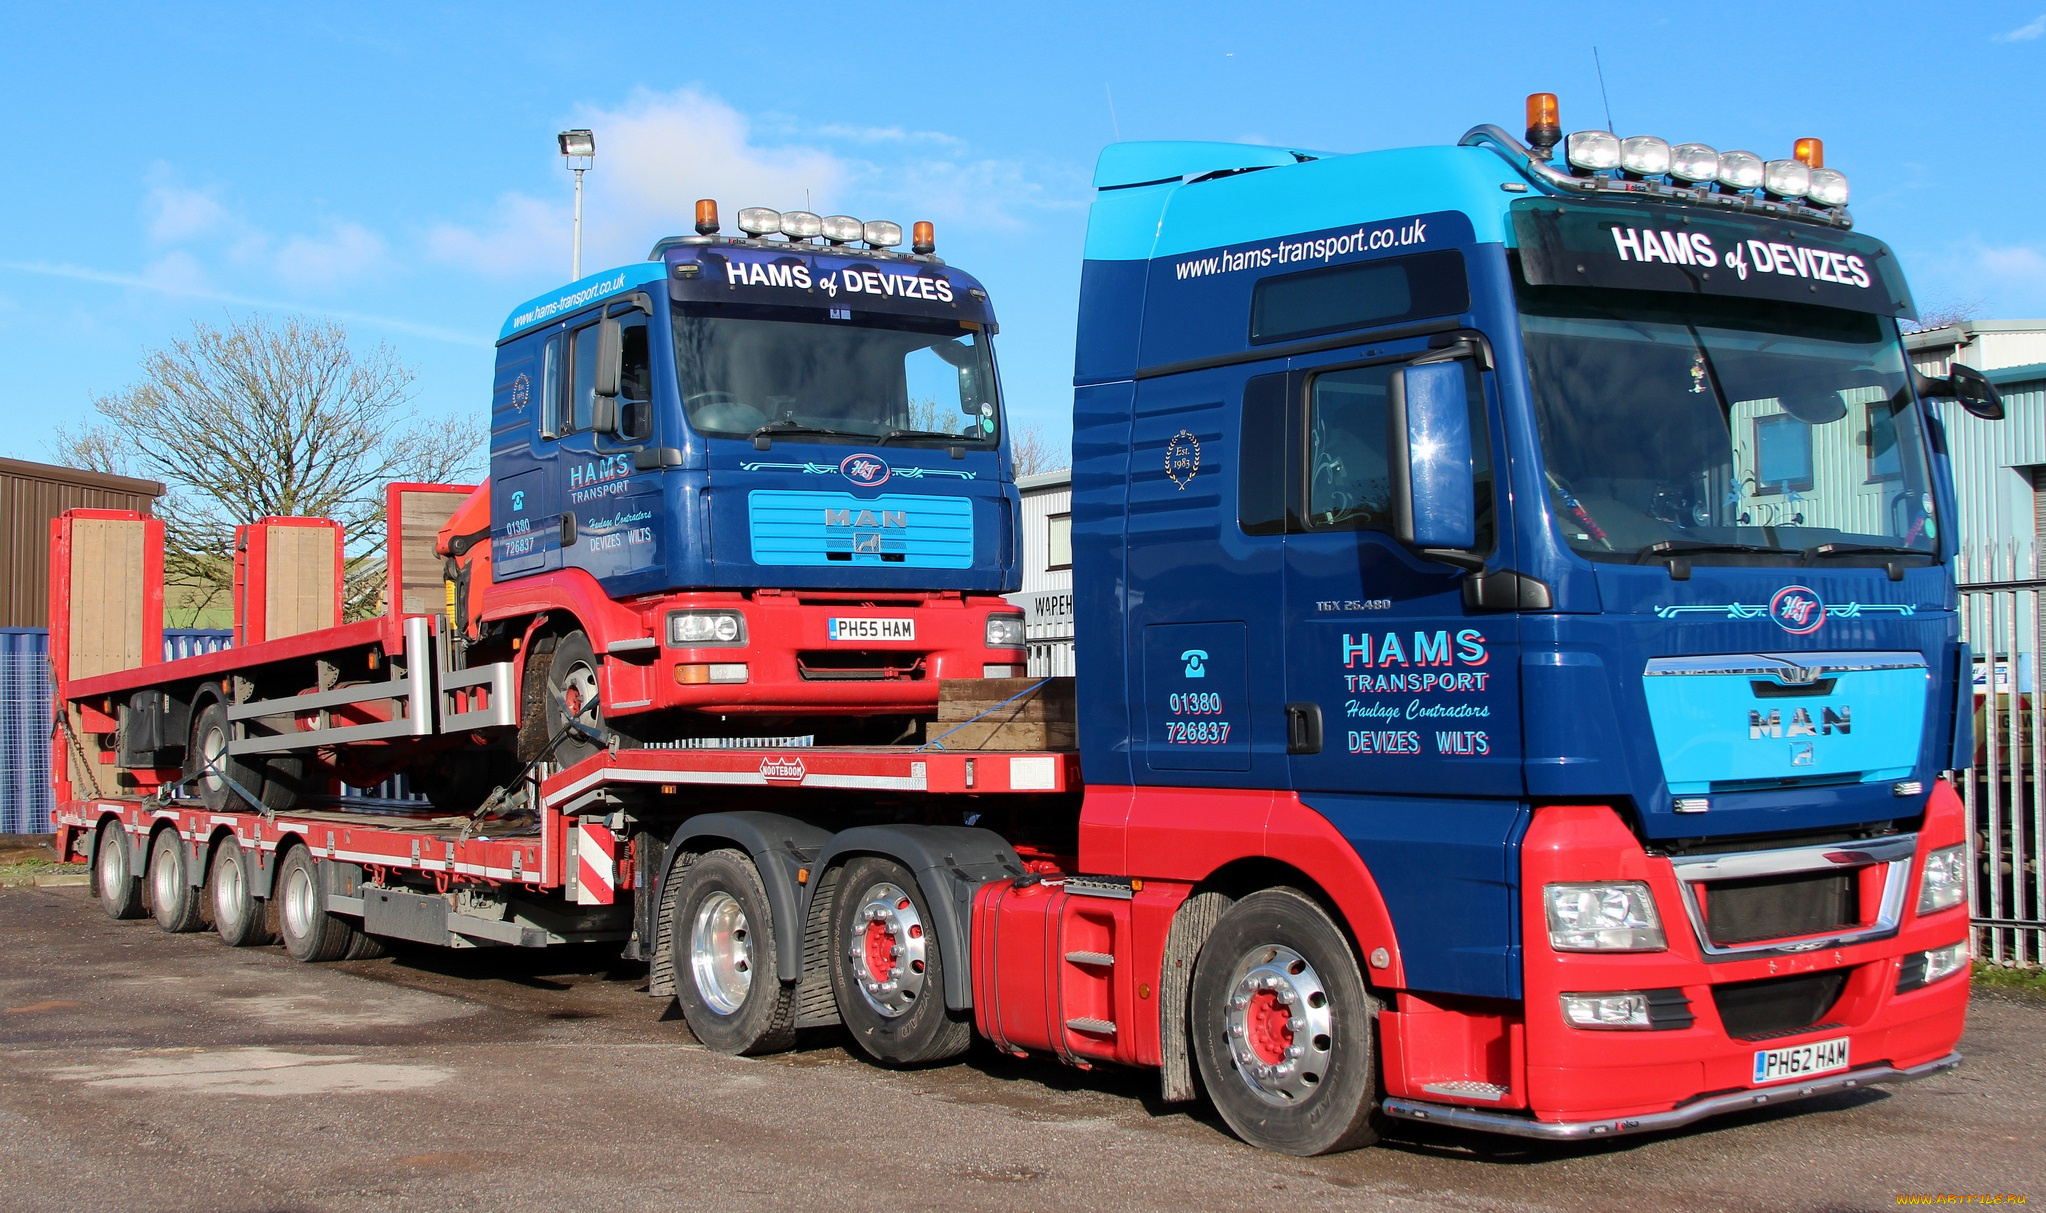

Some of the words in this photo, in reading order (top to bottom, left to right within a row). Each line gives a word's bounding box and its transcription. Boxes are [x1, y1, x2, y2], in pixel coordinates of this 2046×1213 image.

[1175, 218, 1427, 280] www.hams-transport.co.uk
[1611, 226, 1717, 268] HAMS
[1725, 241, 1748, 281] of
[1749, 240, 1870, 288] DEVIZES
[726, 262, 812, 289] HAMS
[819, 271, 838, 298] of
[843, 269, 953, 303] DEVIZES
[513, 272, 626, 329] www.hams-transport.co.uk
[570, 453, 631, 489] HAMS
[1174, 458, 1190, 469] 1983
[571, 479, 630, 504] TRANSPORT
[507, 518, 531, 537] 01380
[588, 518, 613, 530] Haulage
[614, 510, 652, 527] Contractors
[825, 508, 906, 528] MAN
[505, 537, 534, 557] 726837
[590, 533, 621, 553] DEVIZES
[627, 527, 652, 545] WILTS
[1316, 600, 1341, 612] TGX
[1344, 599, 1391, 612] 26.480
[838, 621, 878, 637] PH55
[882, 621, 911, 637] HAM
[1342, 628, 1489, 669] HAMS
[1344, 672, 1490, 693] TRANSPORT
[1169, 692, 1222, 715] 01380
[1344, 699, 1400, 724] Haulage
[1405, 698, 1491, 720] Contractors
[1166, 721, 1231, 744] 726837
[1748, 705, 1851, 740] MAN
[1348, 730, 1420, 755] DEVIZES
[1436, 730, 1490, 755] WILTS
[762, 765, 803, 777] NOOTEBOOM
[1766, 1047, 1811, 1077] PH62
[1815, 1040, 1846, 1069] HAM
